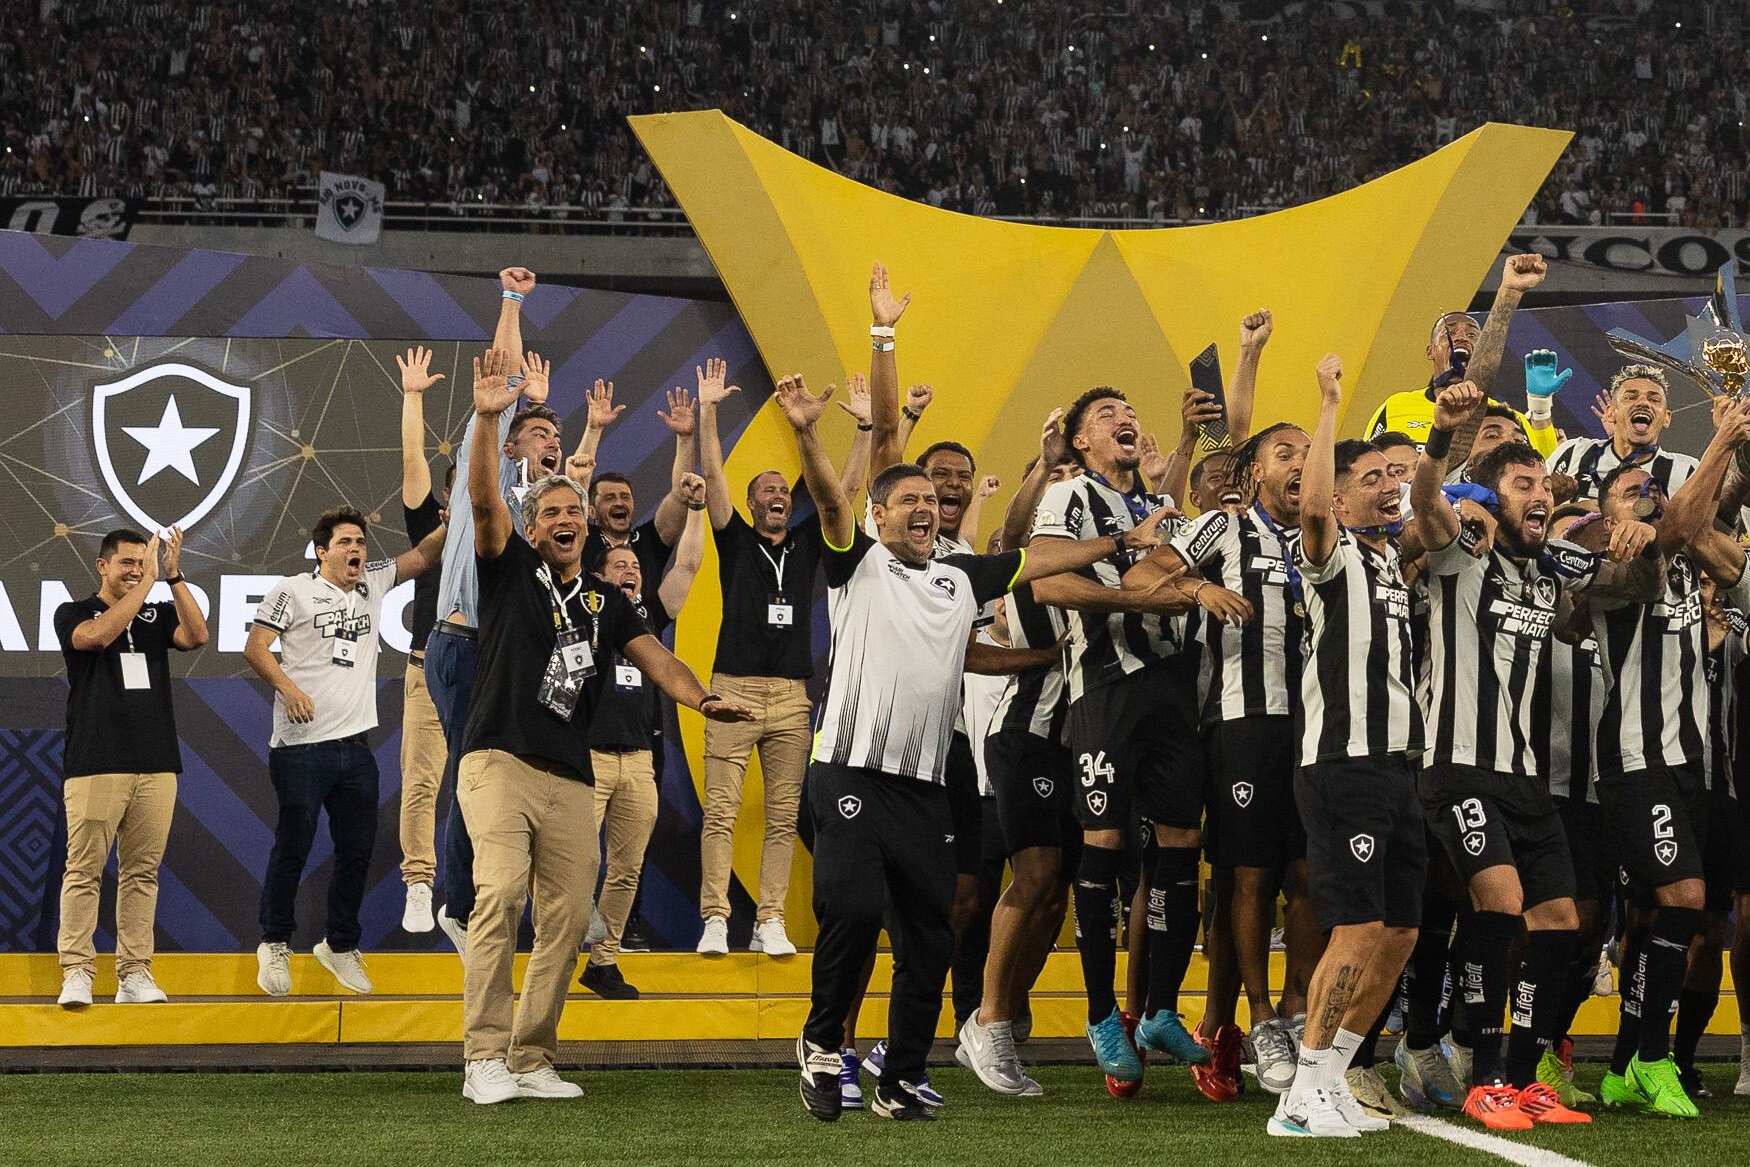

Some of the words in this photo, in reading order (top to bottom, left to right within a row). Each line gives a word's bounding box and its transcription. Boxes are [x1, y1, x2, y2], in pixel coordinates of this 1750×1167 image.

[1079, 751, 1115, 787] 34
[1452, 798, 1487, 833] 13
[1651, 804, 1675, 840] 2
[1519, 981, 1537, 1019] Lifefit
